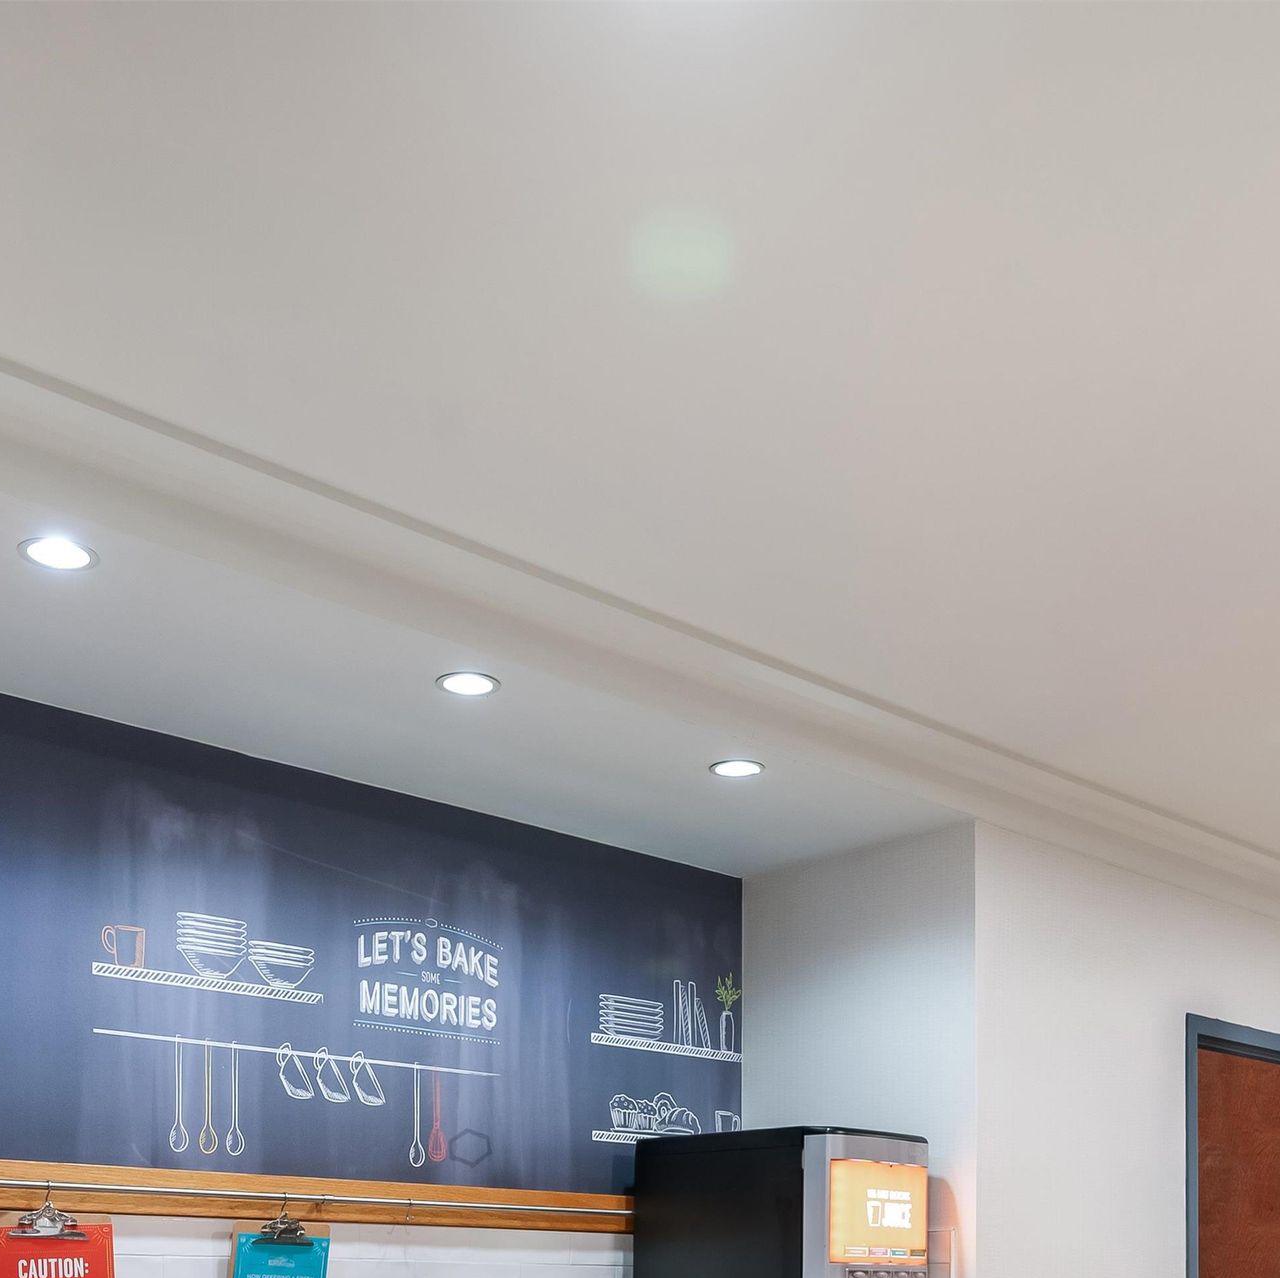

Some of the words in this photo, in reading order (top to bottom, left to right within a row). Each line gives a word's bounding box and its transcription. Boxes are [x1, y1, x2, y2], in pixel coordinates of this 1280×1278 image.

[358, 930, 427, 967] LET'S
[436, 936, 499, 988] BAKE
[421, 970, 441, 985] SOME
[359, 979, 497, 1031] MEMORIES
